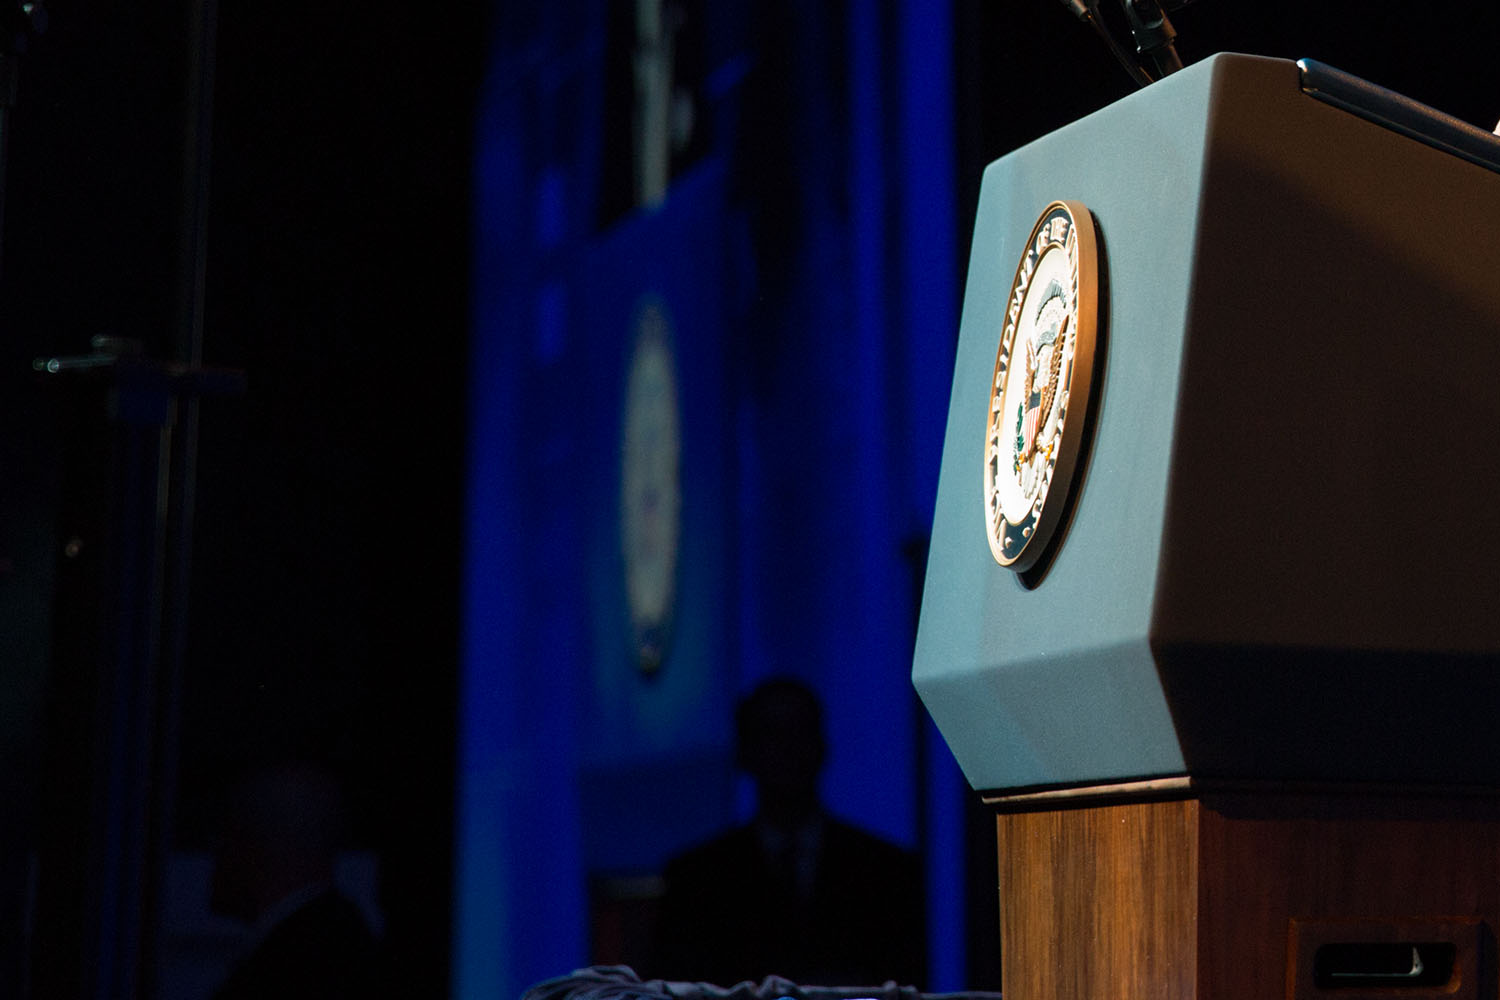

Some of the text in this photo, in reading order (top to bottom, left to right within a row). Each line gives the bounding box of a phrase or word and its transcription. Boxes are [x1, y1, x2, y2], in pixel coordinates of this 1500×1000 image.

[989, 249, 1034, 465] PRESIDENT
[1036, 223, 1051, 256] OF
[1050, 216, 1069, 243] THE
